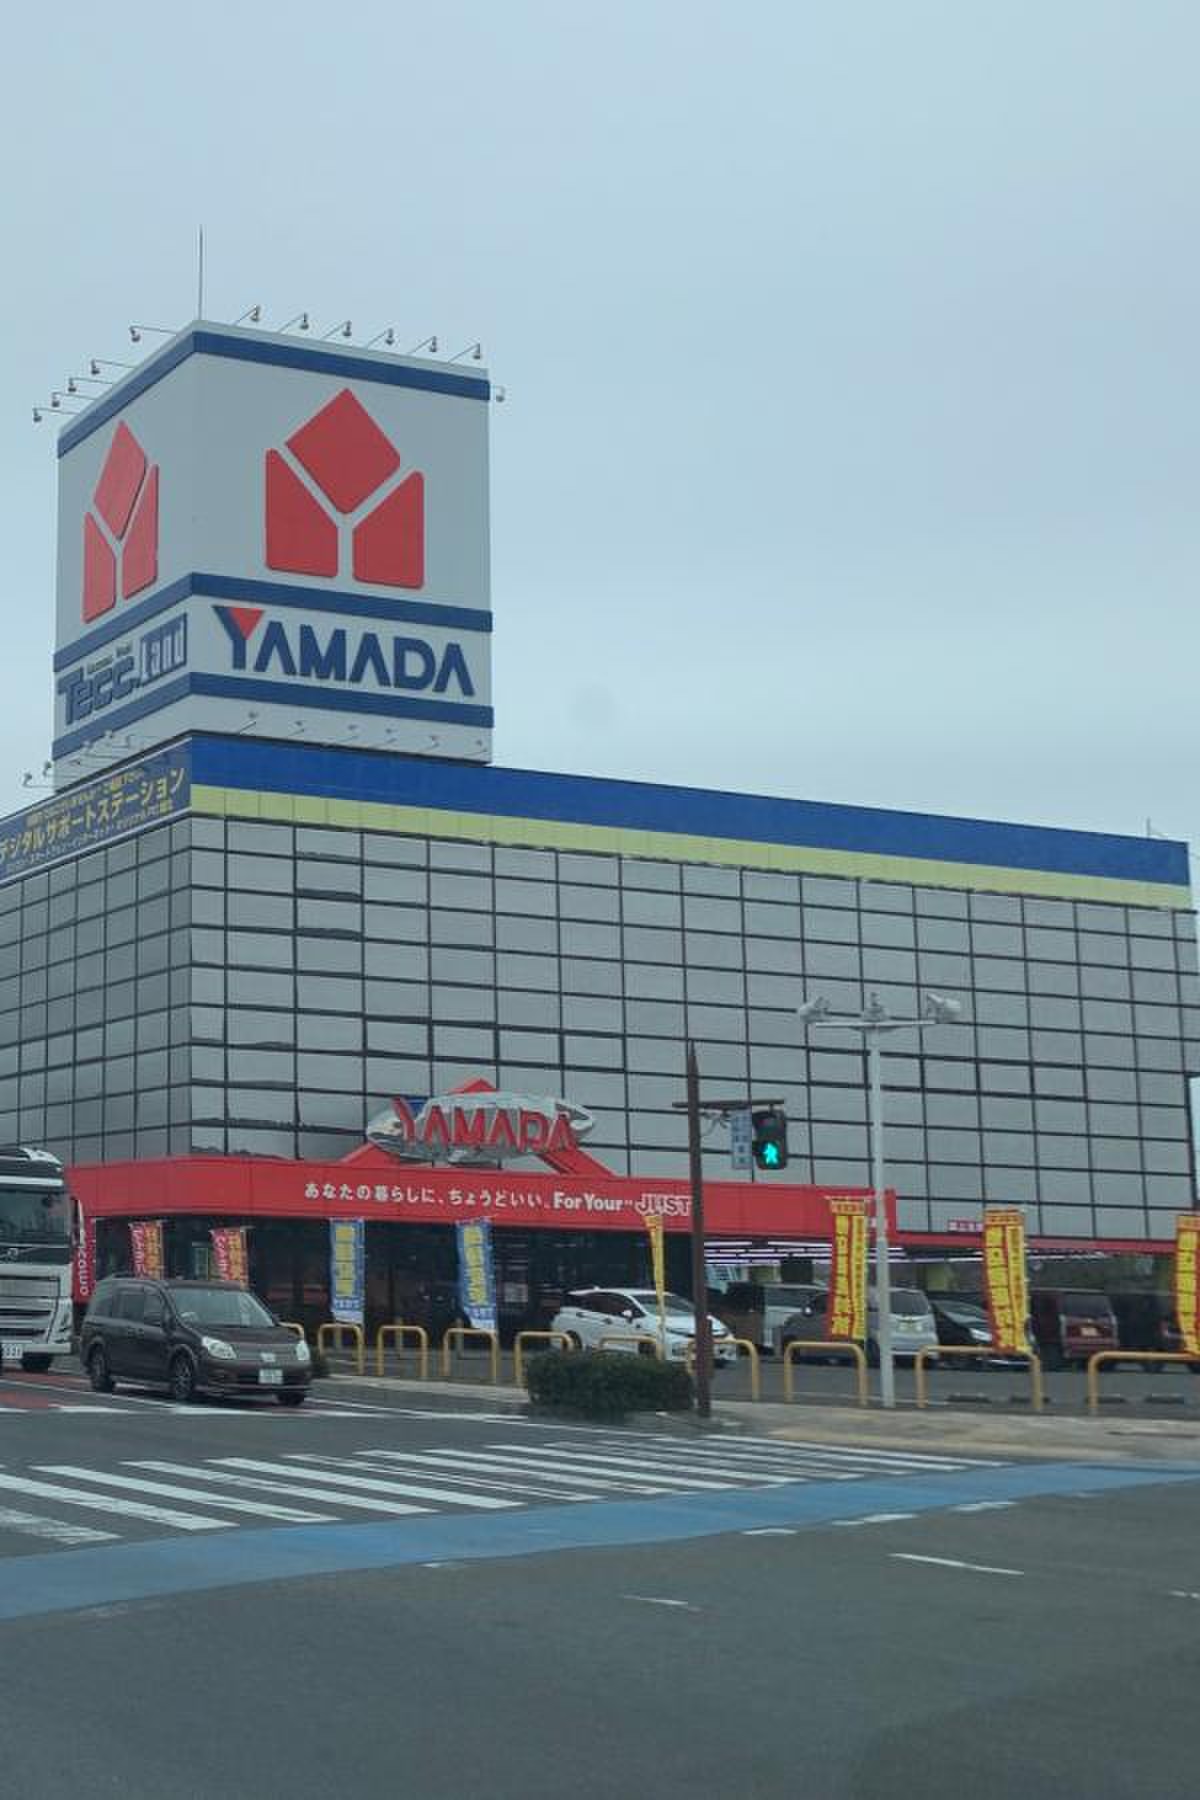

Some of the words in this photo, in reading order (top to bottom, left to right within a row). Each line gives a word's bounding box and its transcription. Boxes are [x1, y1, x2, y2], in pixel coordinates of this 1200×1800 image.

[211, 604, 475, 696] YAMADA
[392, 1096, 580, 1152] YAMADA
[553, 1190, 582, 1210] For
